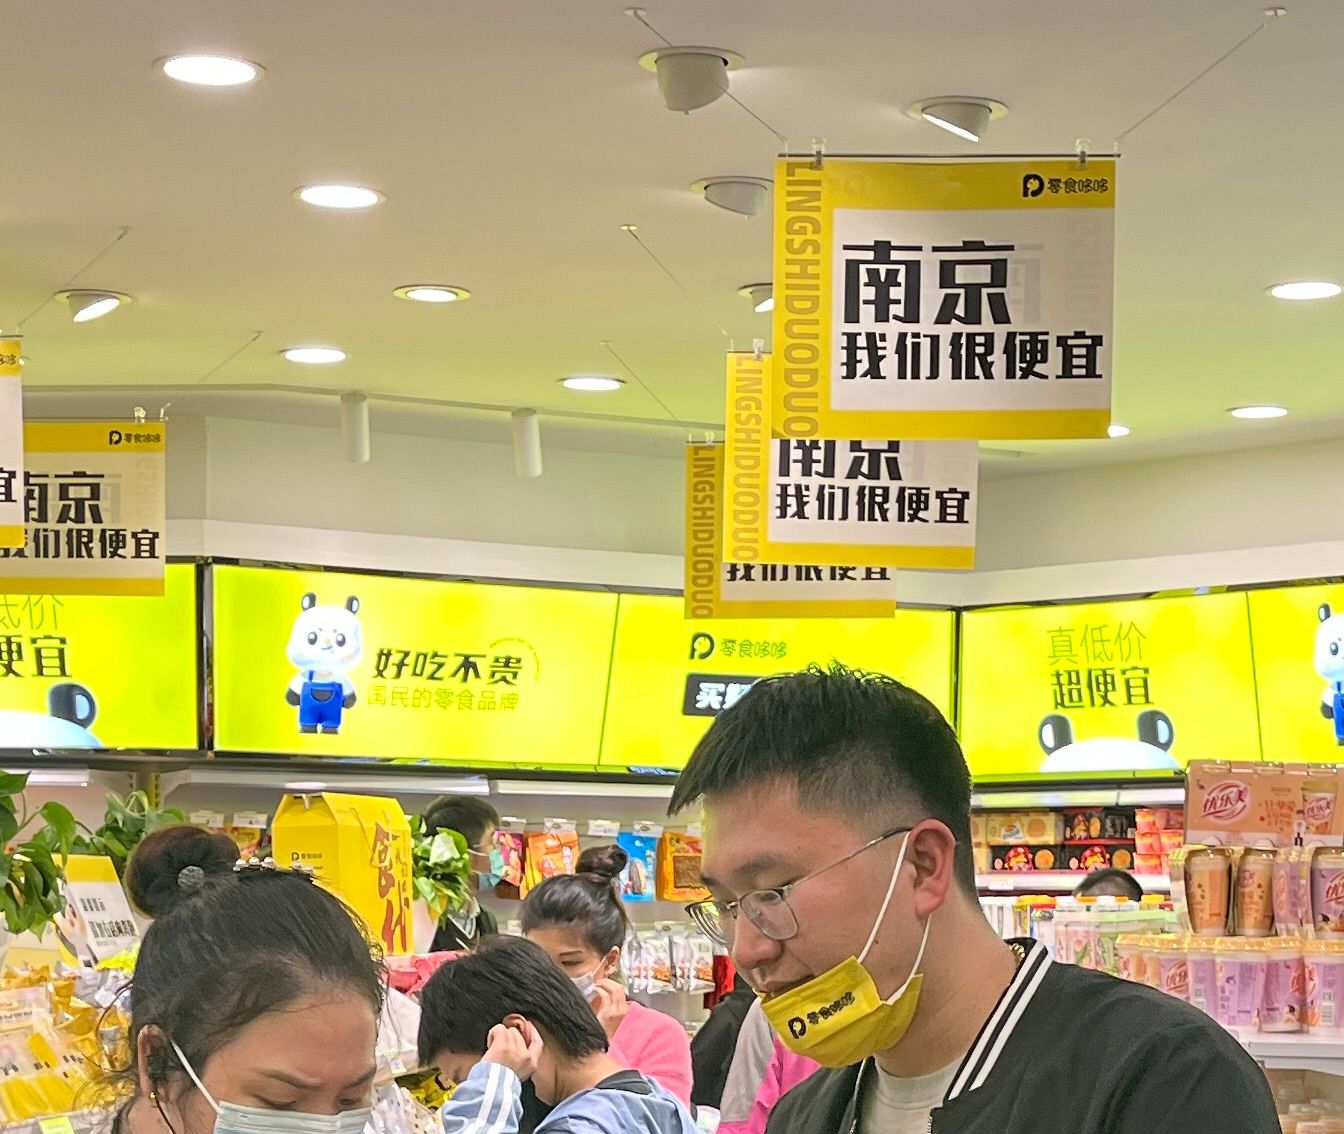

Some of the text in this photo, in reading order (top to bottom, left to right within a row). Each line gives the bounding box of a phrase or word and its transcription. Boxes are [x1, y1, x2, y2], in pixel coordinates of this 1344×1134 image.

[783, 161, 824, 439] LINGSHIDUODUO
[842, 240, 1016, 326] 南京
[840, 330, 1105, 382] 我们很便宜
[731, 354, 763, 563] LINGSHIDUODUO
[775, 483, 971, 525] 我们很便宜
[689, 445, 717, 619] LINGSHIDUODUO
[371, 645, 525, 687] 好吃不贵
[1045, 621, 1147, 667] 真低价
[366, 684, 520, 712] 国民的零食品牌
[1049, 664, 1155, 711] 超便宜
